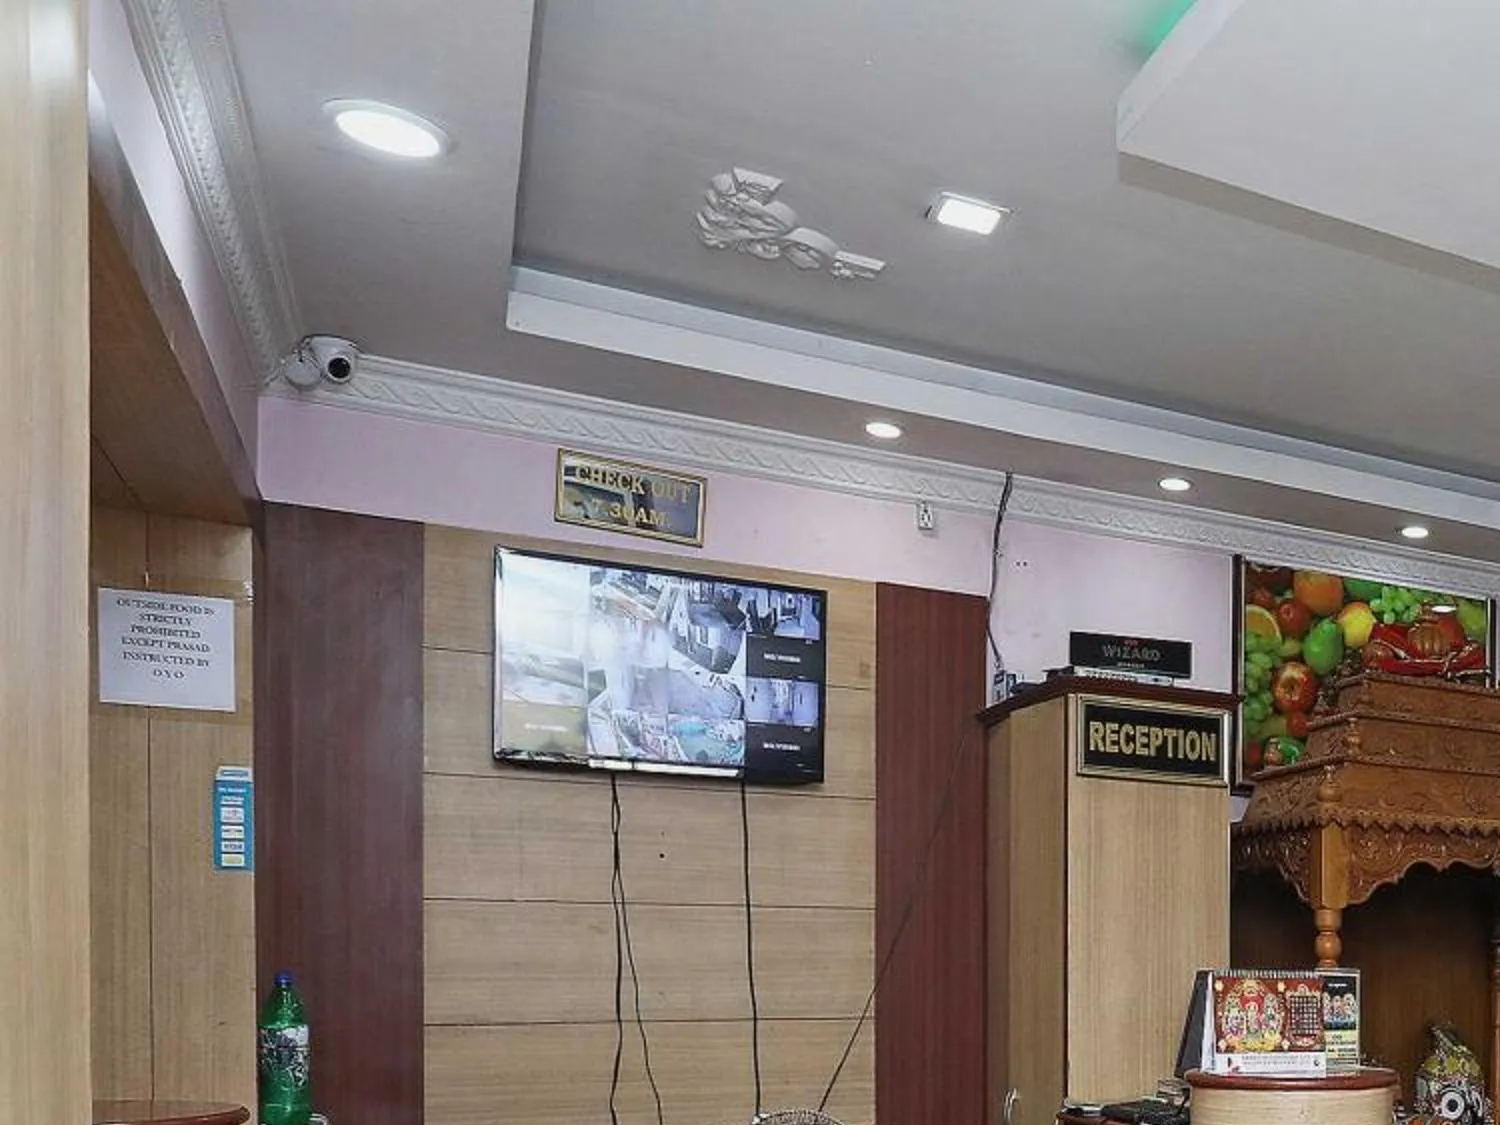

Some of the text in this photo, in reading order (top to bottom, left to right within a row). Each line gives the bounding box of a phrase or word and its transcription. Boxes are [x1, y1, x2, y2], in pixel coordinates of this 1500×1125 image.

[576, 463, 692, 504] CHECK OUT
[1102, 643, 1161, 662] WIZARD
[1088, 720, 1217, 762] RECEPTION
